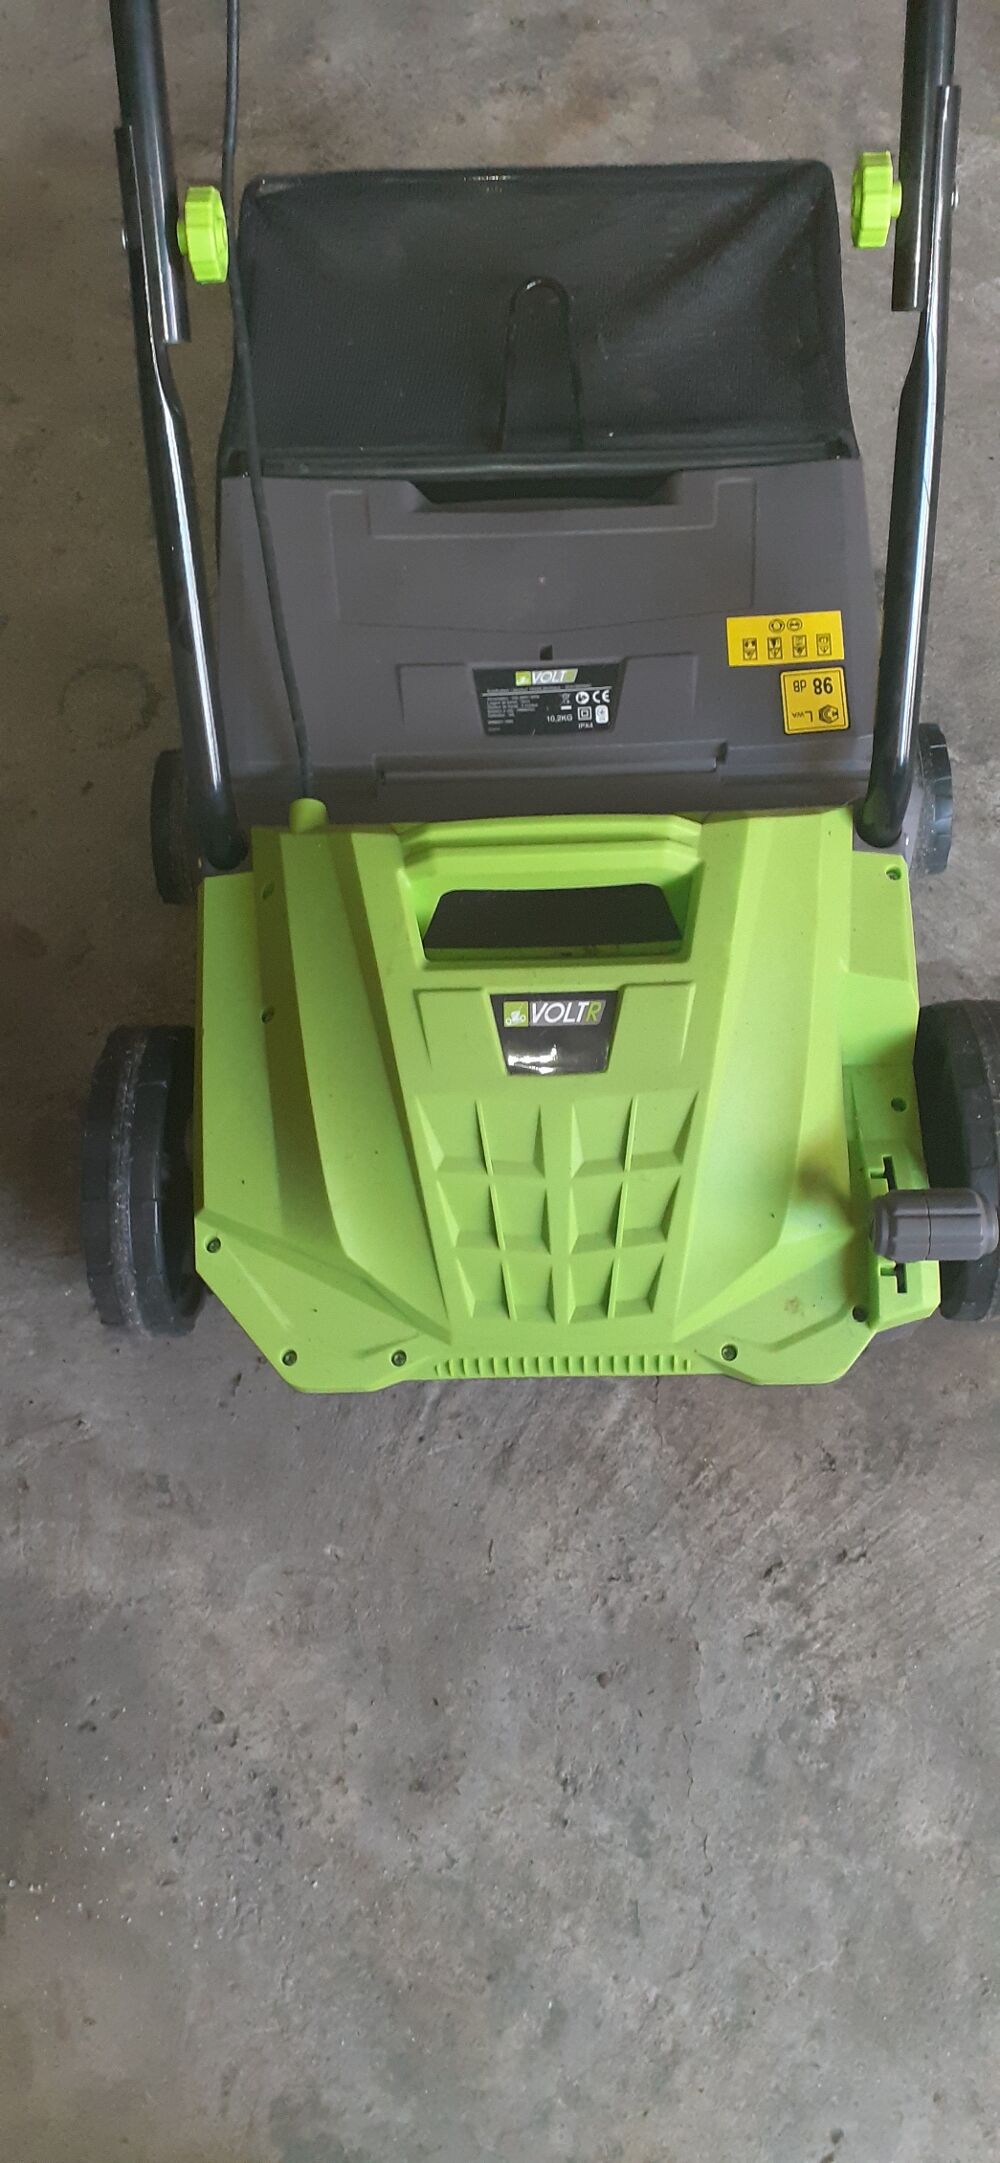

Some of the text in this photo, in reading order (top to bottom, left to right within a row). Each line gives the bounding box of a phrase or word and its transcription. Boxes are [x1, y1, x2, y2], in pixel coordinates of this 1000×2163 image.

[793, 677, 833, 695] 98 dB
[547, 714, 573, 723] 10.2KG
[532, 1001, 602, 1024] VOLTR
